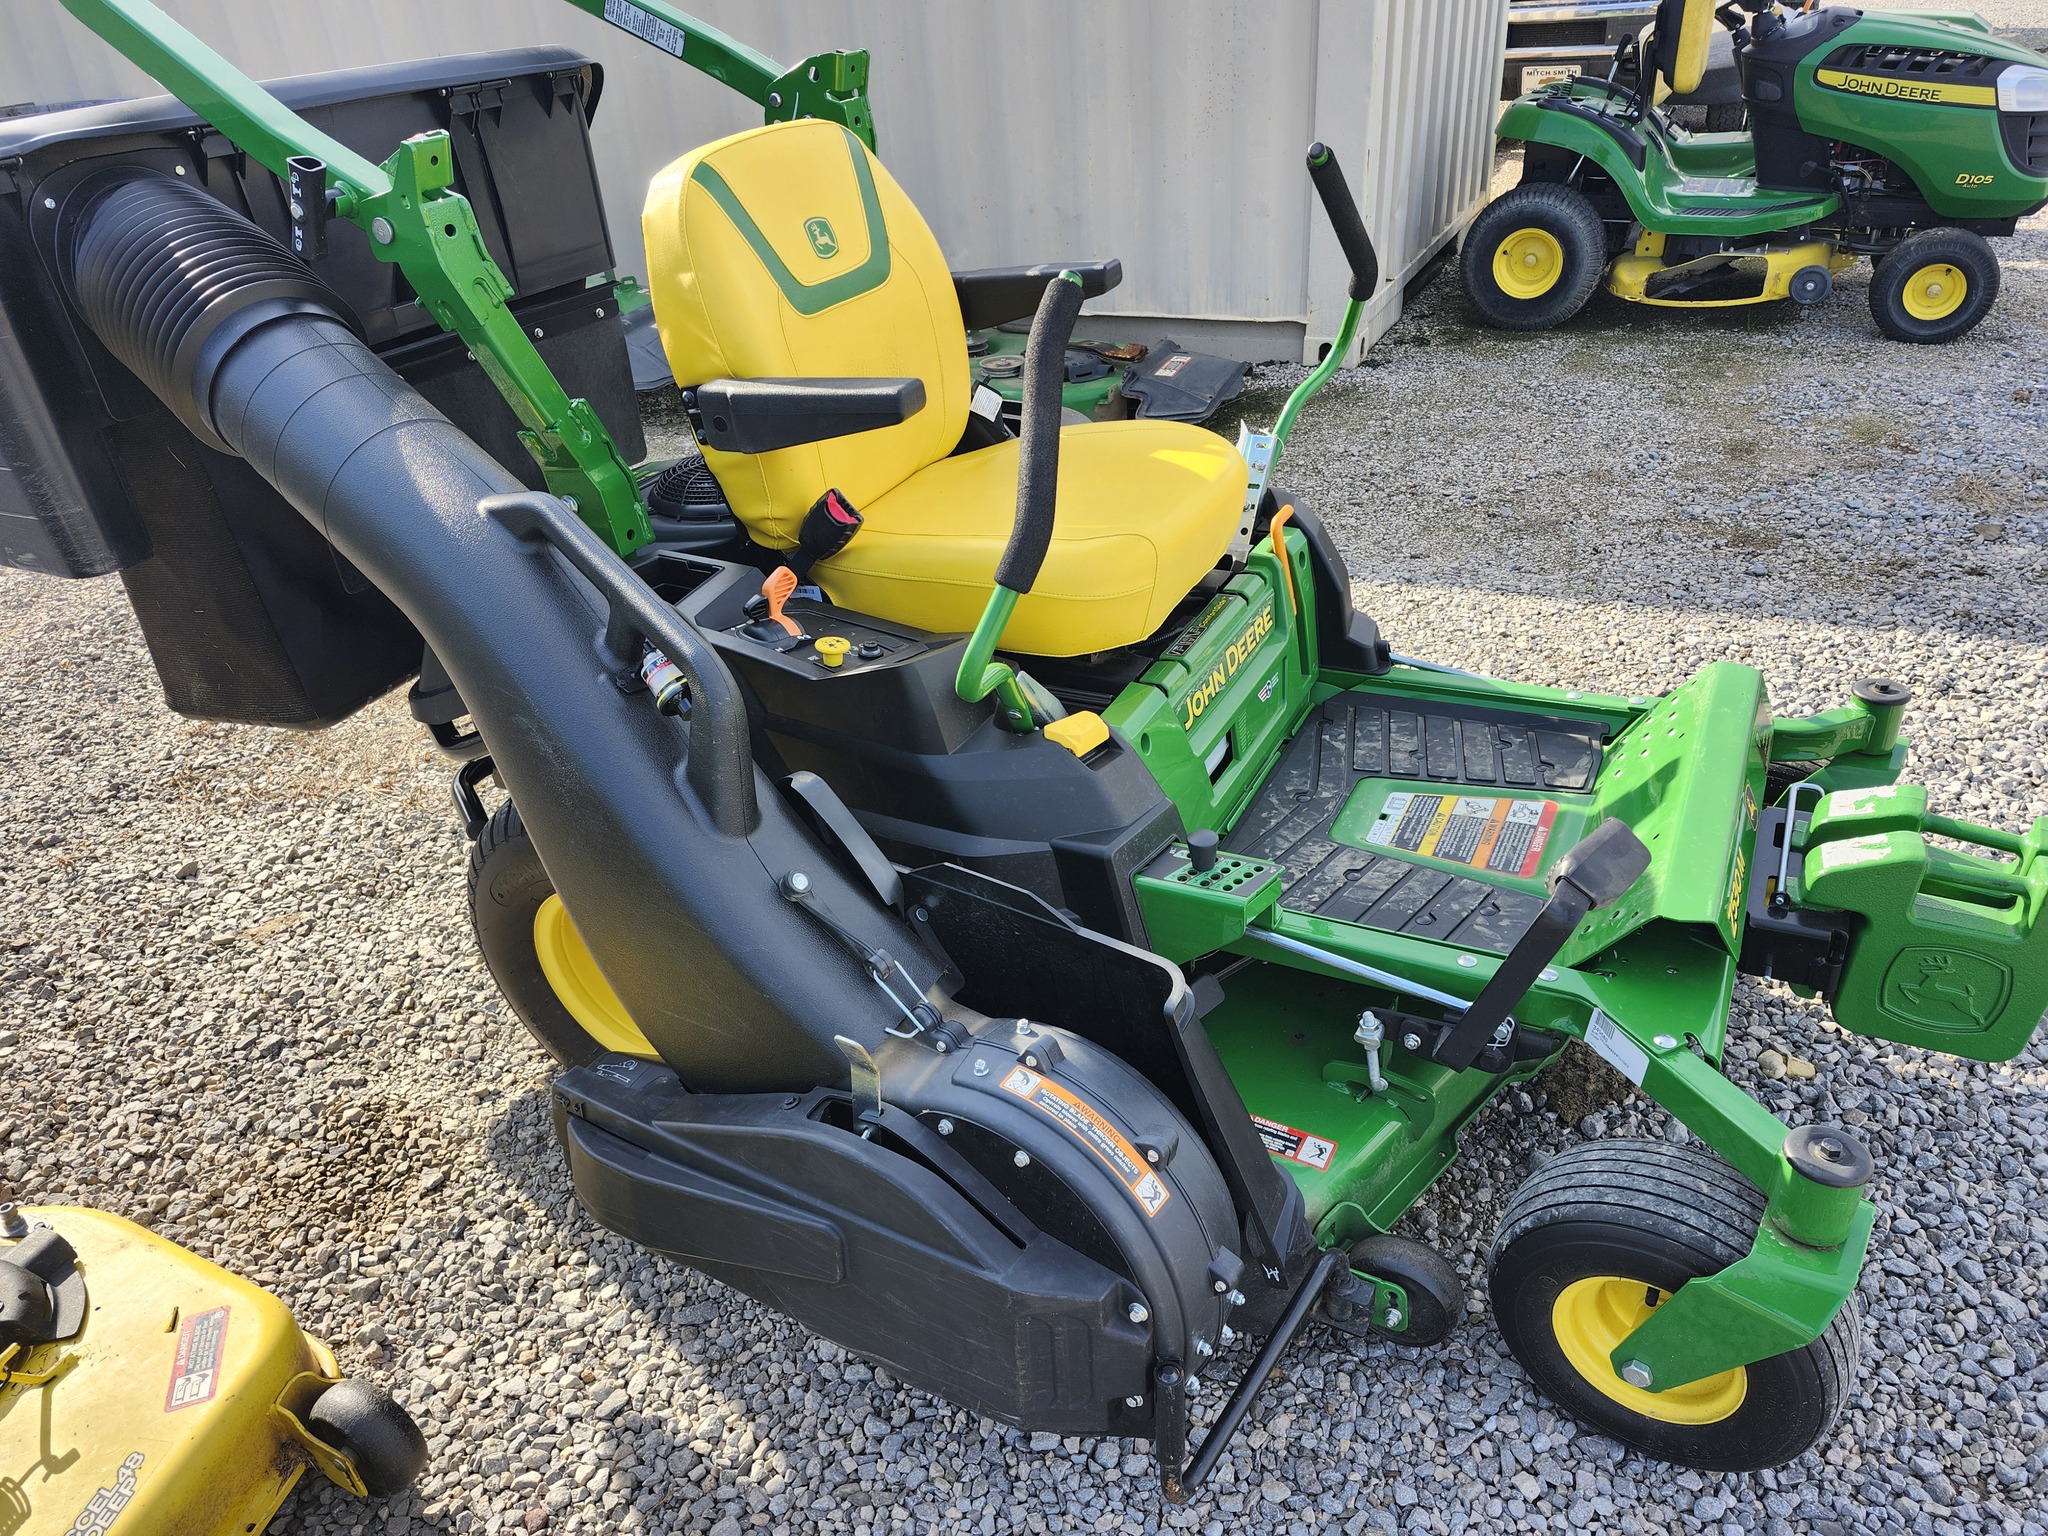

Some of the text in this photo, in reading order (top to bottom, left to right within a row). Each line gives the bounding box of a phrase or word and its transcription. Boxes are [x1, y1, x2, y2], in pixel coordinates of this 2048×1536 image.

[1837, 75, 1942, 101] JOHN DEERE
[1956, 173, 1994, 185] D105
[1184, 662, 1226, 731] JOHN
[1225, 604, 1273, 677] DEERE
[1428, 818, 1444, 836] CAUTION
[1481, 825, 1498, 846] WARNING
[1531, 832, 1547, 852] DANGER
[1039, 1100, 1059, 1117] secured
[1062, 1116, 1077, 1130] place
[1081, 1106, 1121, 1144] WARNING
[1255, 1116, 1289, 1132] DANGER
[1040, 1088, 1070, 1109] ROTATING
[1069, 1103, 1089, 1125] BLADE
[1091, 1125, 1115, 1150] THROWN
[1115, 1148, 1139, 1174] OBJECTS
[1061, 1108, 1078, 1123] blower
[1078, 1121, 1089, 1132] with
[1088, 1129, 1102, 1144] entire
[1100, 1142, 1114, 1157] grass
[178, 1330, 190, 1360] DANGER
[117, 1451, 145, 1484] 48
